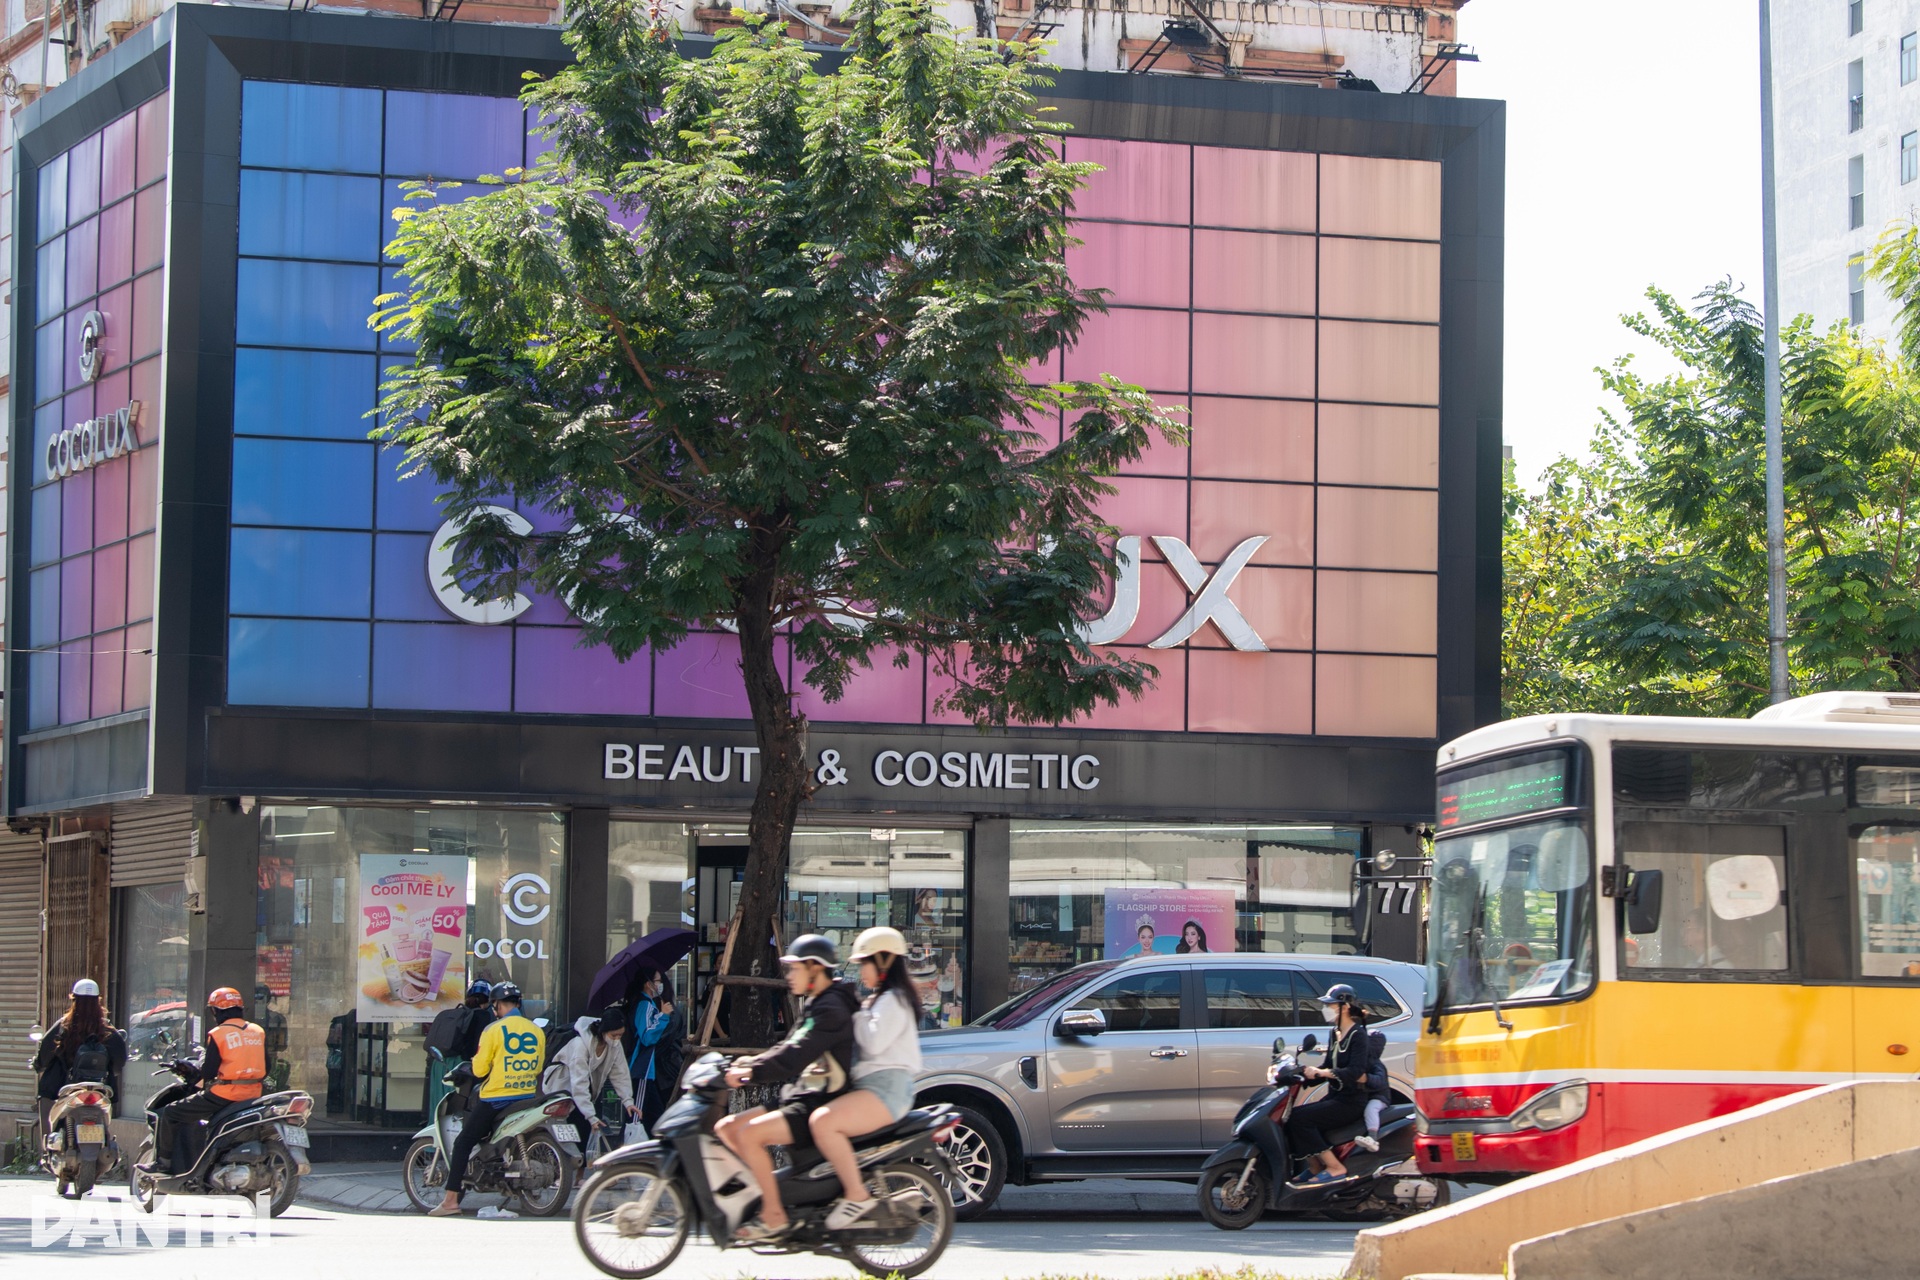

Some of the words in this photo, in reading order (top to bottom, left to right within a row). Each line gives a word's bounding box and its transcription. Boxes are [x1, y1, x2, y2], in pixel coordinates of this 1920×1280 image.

[46, 400, 140, 480] COCOLUX
[604, 743, 761, 783] BEAUT
[817, 749, 849, 786] &
[874, 750, 1100, 790] COSMETIC
[371, 884, 404, 896] Cool
[407, 880, 434, 896] MÊ
[437, 884, 455, 898] LY
[1376, 882, 1416, 914] 77
[1117, 904, 1158, 912] FLAGSHIP
[1159, 904, 1187, 912] STORE
[502, 1025, 538, 1055] be
[504, 1055, 538, 1072] Food
